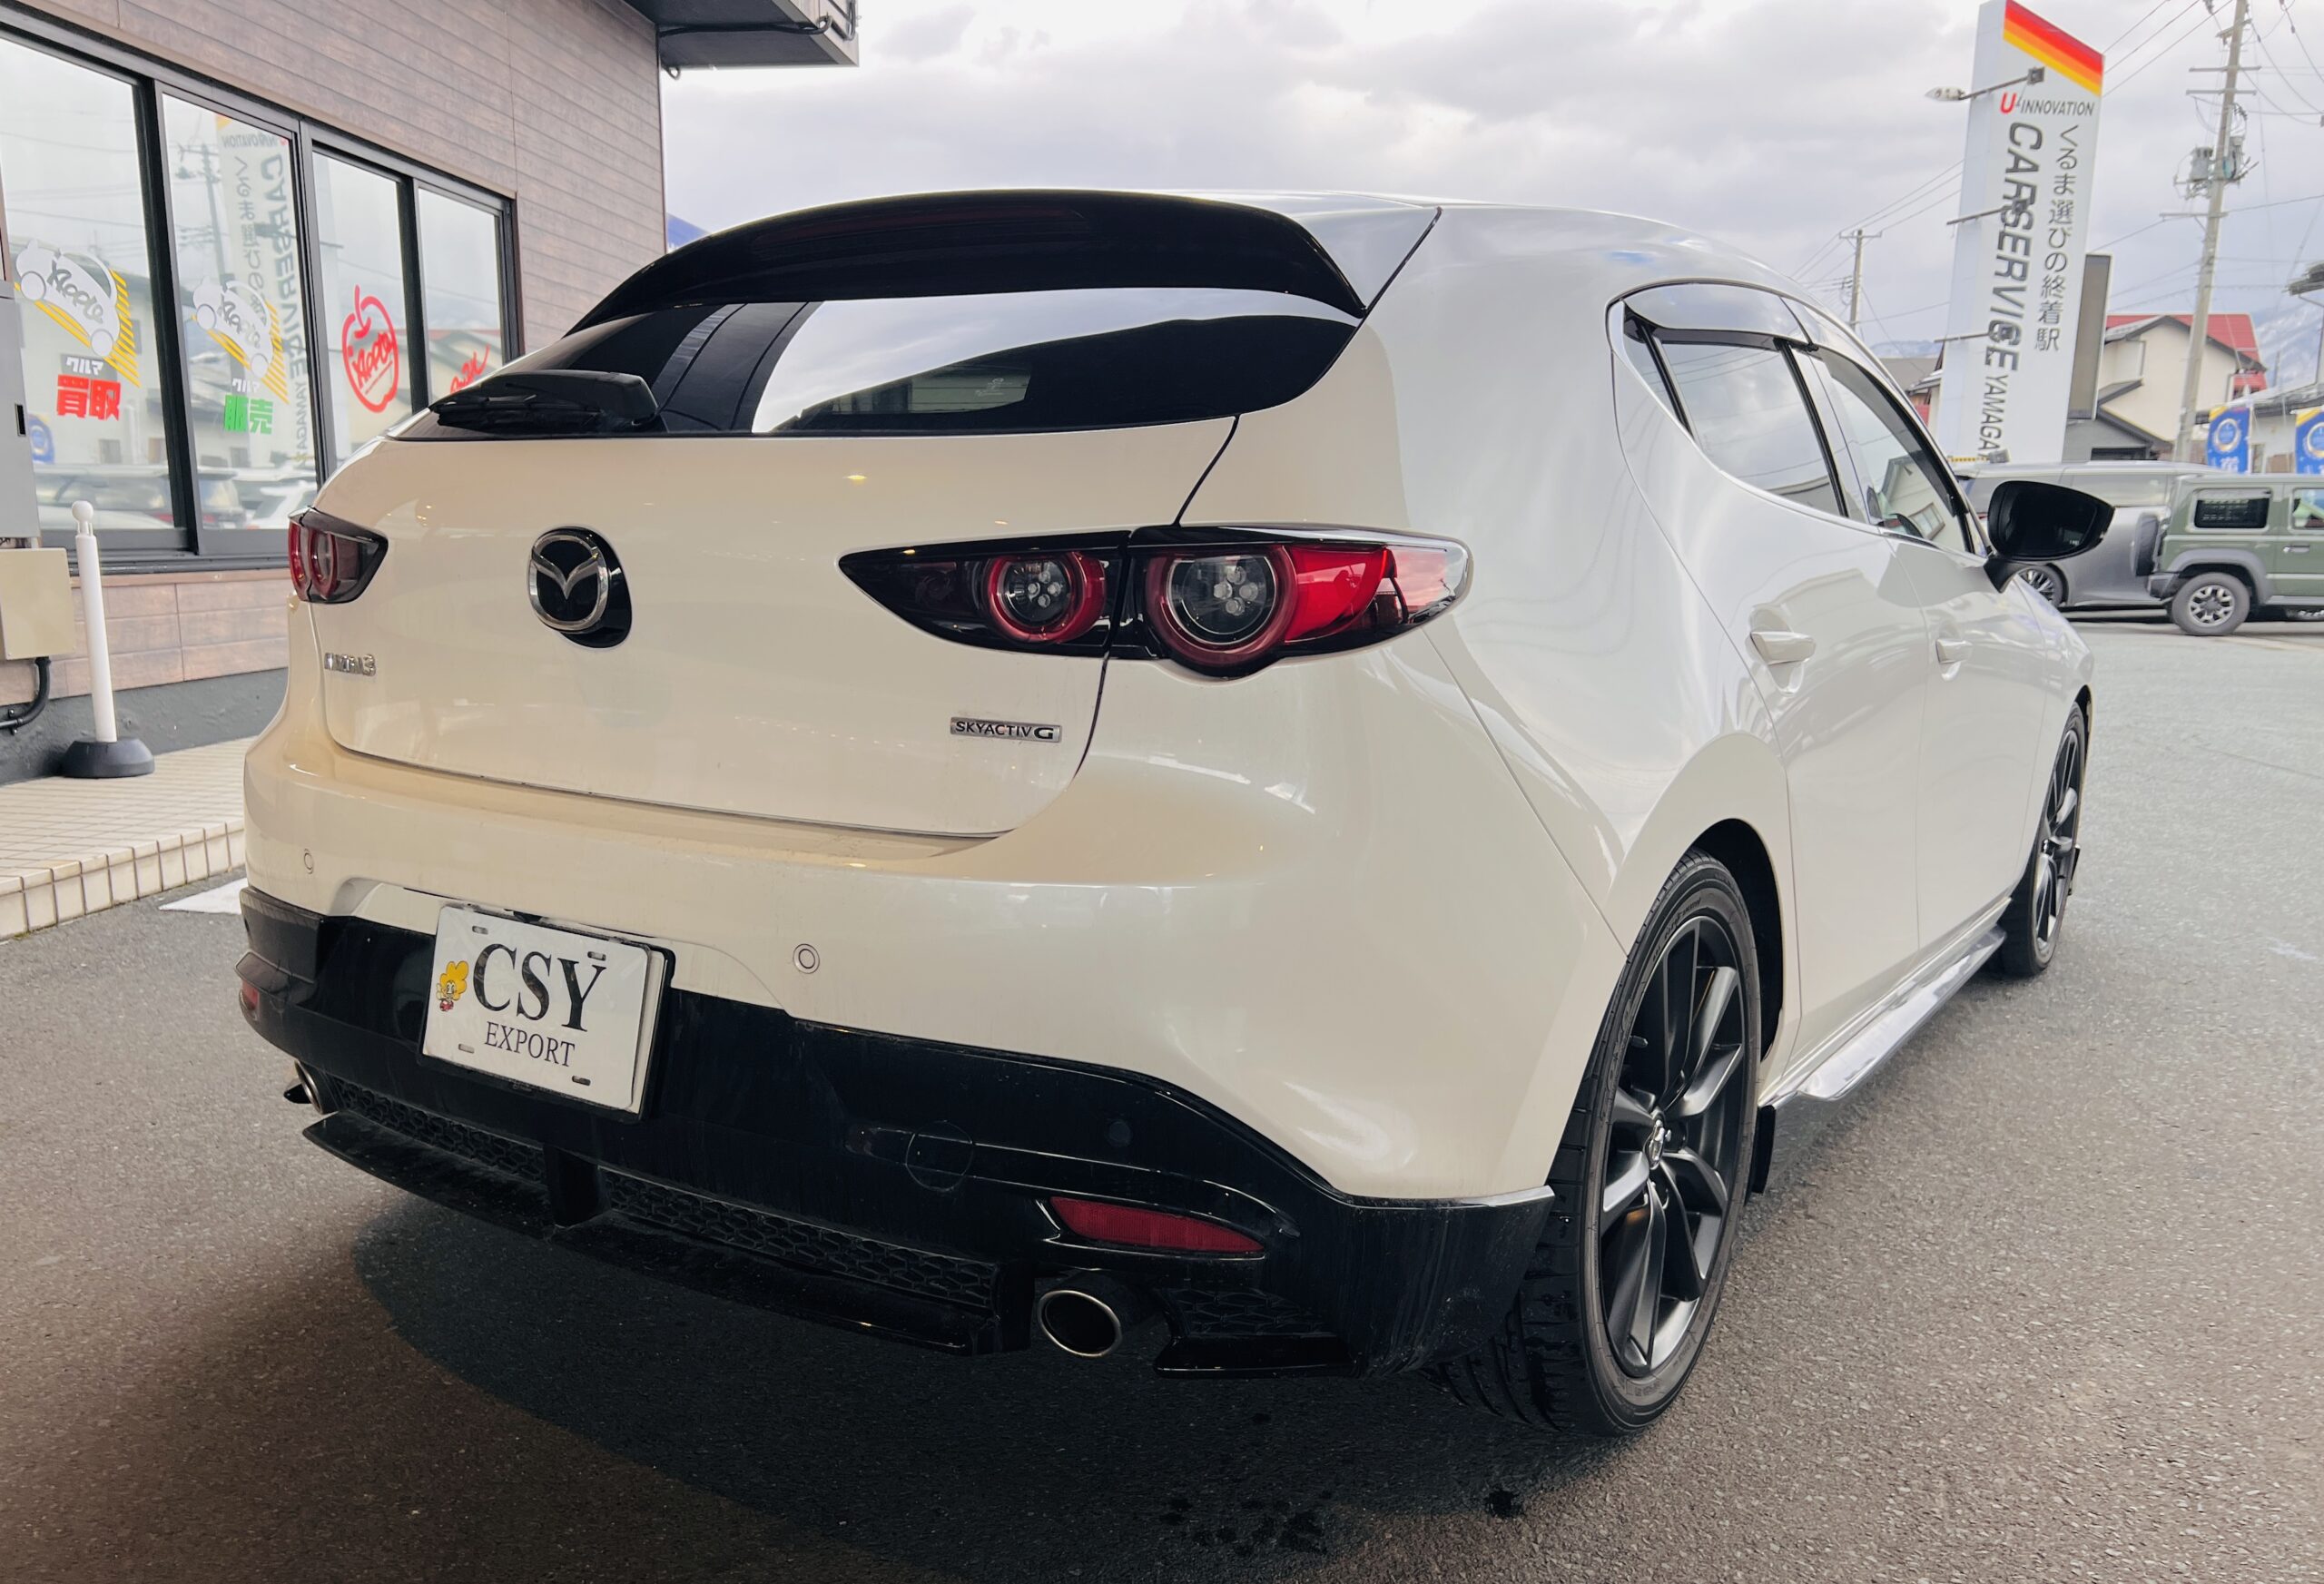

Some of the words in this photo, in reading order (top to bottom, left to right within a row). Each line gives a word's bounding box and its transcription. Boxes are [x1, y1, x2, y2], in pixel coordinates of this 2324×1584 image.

[2034, 124, 2080, 352] くるま選びの終着駅
[65, 356, 104, 376] クルマ
[56, 374, 122, 421] 買取
[223, 394, 274, 435] 販売
[1976, 374, 2009, 457] YAMAGA
[955, 721, 1032, 737] SKYACTIV
[472, 942, 607, 1033] CSY
[484, 1020, 576, 1067] EXPORT
